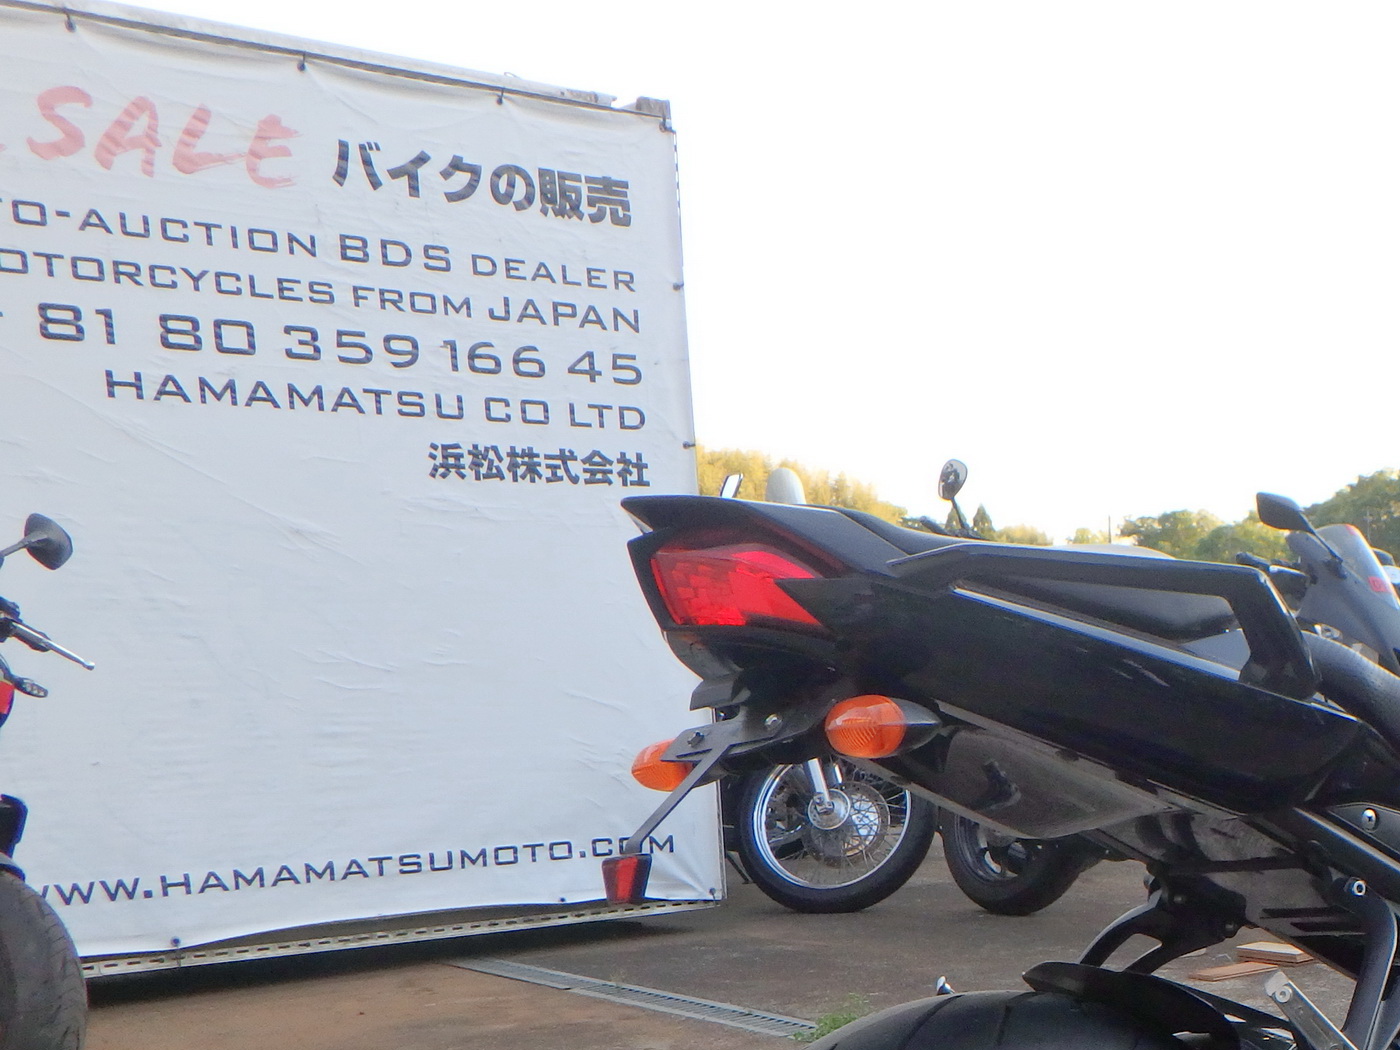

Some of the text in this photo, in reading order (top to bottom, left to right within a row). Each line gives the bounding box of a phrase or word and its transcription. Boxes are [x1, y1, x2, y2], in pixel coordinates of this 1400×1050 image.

[332, 139, 632, 228] バイクの販売
[0, 198, 636, 293] O-AUCTION BDS DEALER
[37, 302, 643, 386] 81 80 359 166 45
[352, 285, 472, 319] FROM
[488, 296, 640, 334] JAPAN
[104, 369, 646, 431] HAMAMATSU CO LTD
[427, 442, 651, 488] 浜松株式会社
[40, 834, 675, 906] WW.HAMAMATSUMOTO.CM
